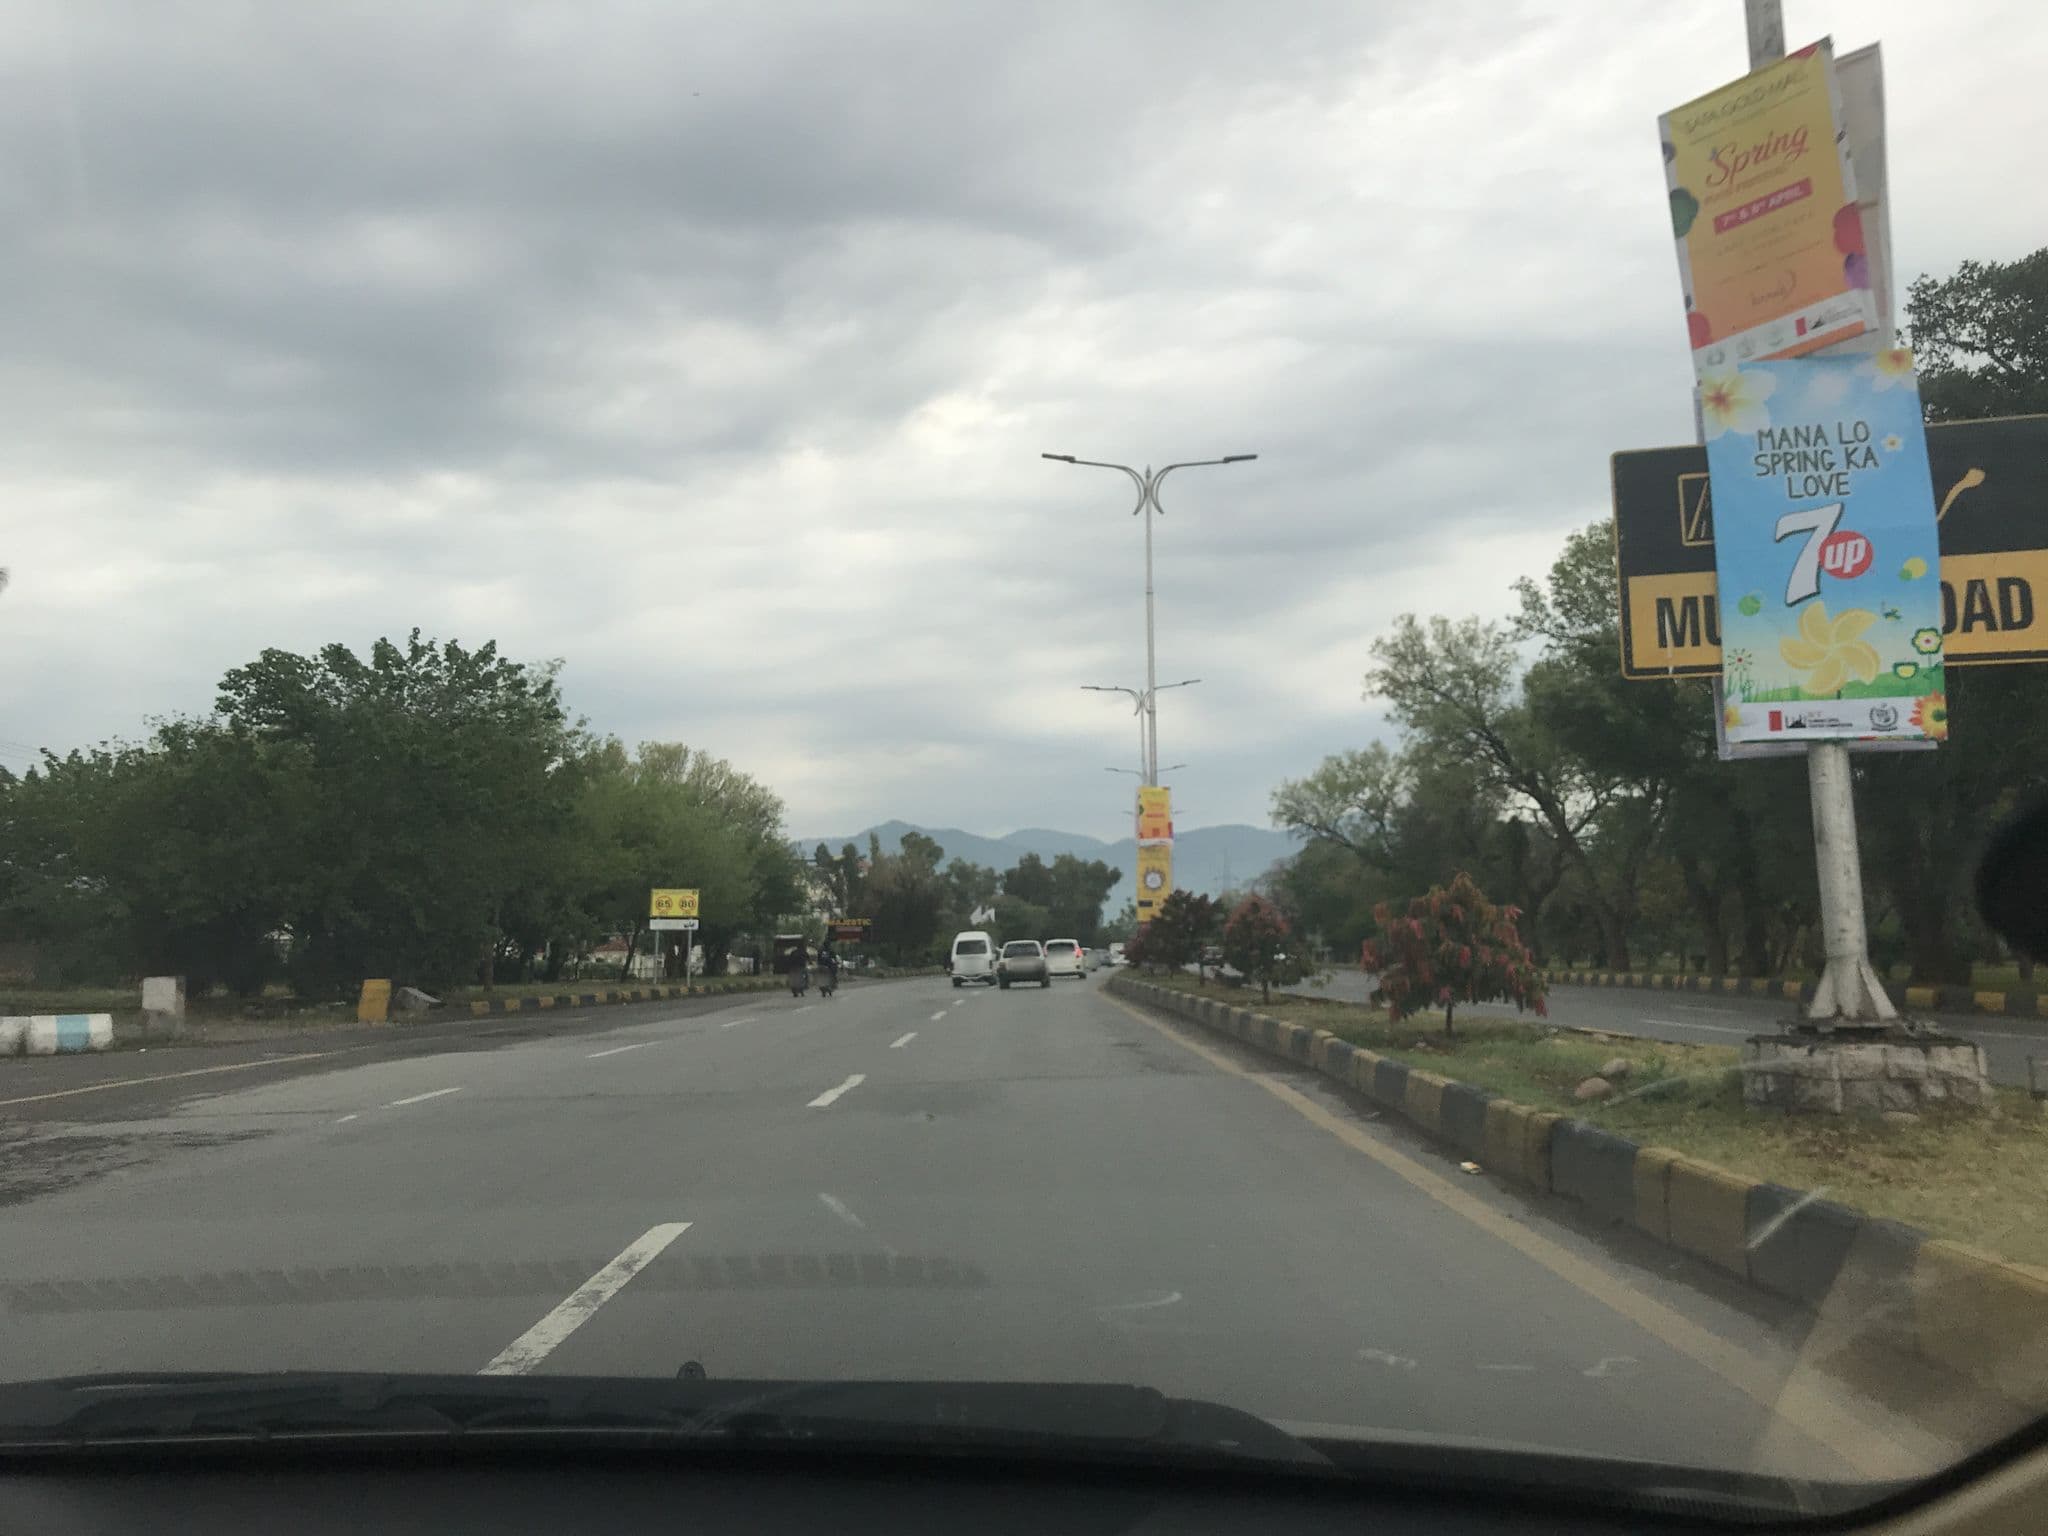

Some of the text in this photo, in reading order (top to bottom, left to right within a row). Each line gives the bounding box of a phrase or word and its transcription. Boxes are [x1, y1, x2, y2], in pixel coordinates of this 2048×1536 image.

[1706, 126, 1810, 190] Spring
[1757, 420, 1870, 451] MANA LO
[1754, 445, 1879, 476] SPRING KA
[1787, 471, 1851, 499] LOVE
[657, 900, 671, 908] 65
[681, 899, 694, 908] 80
